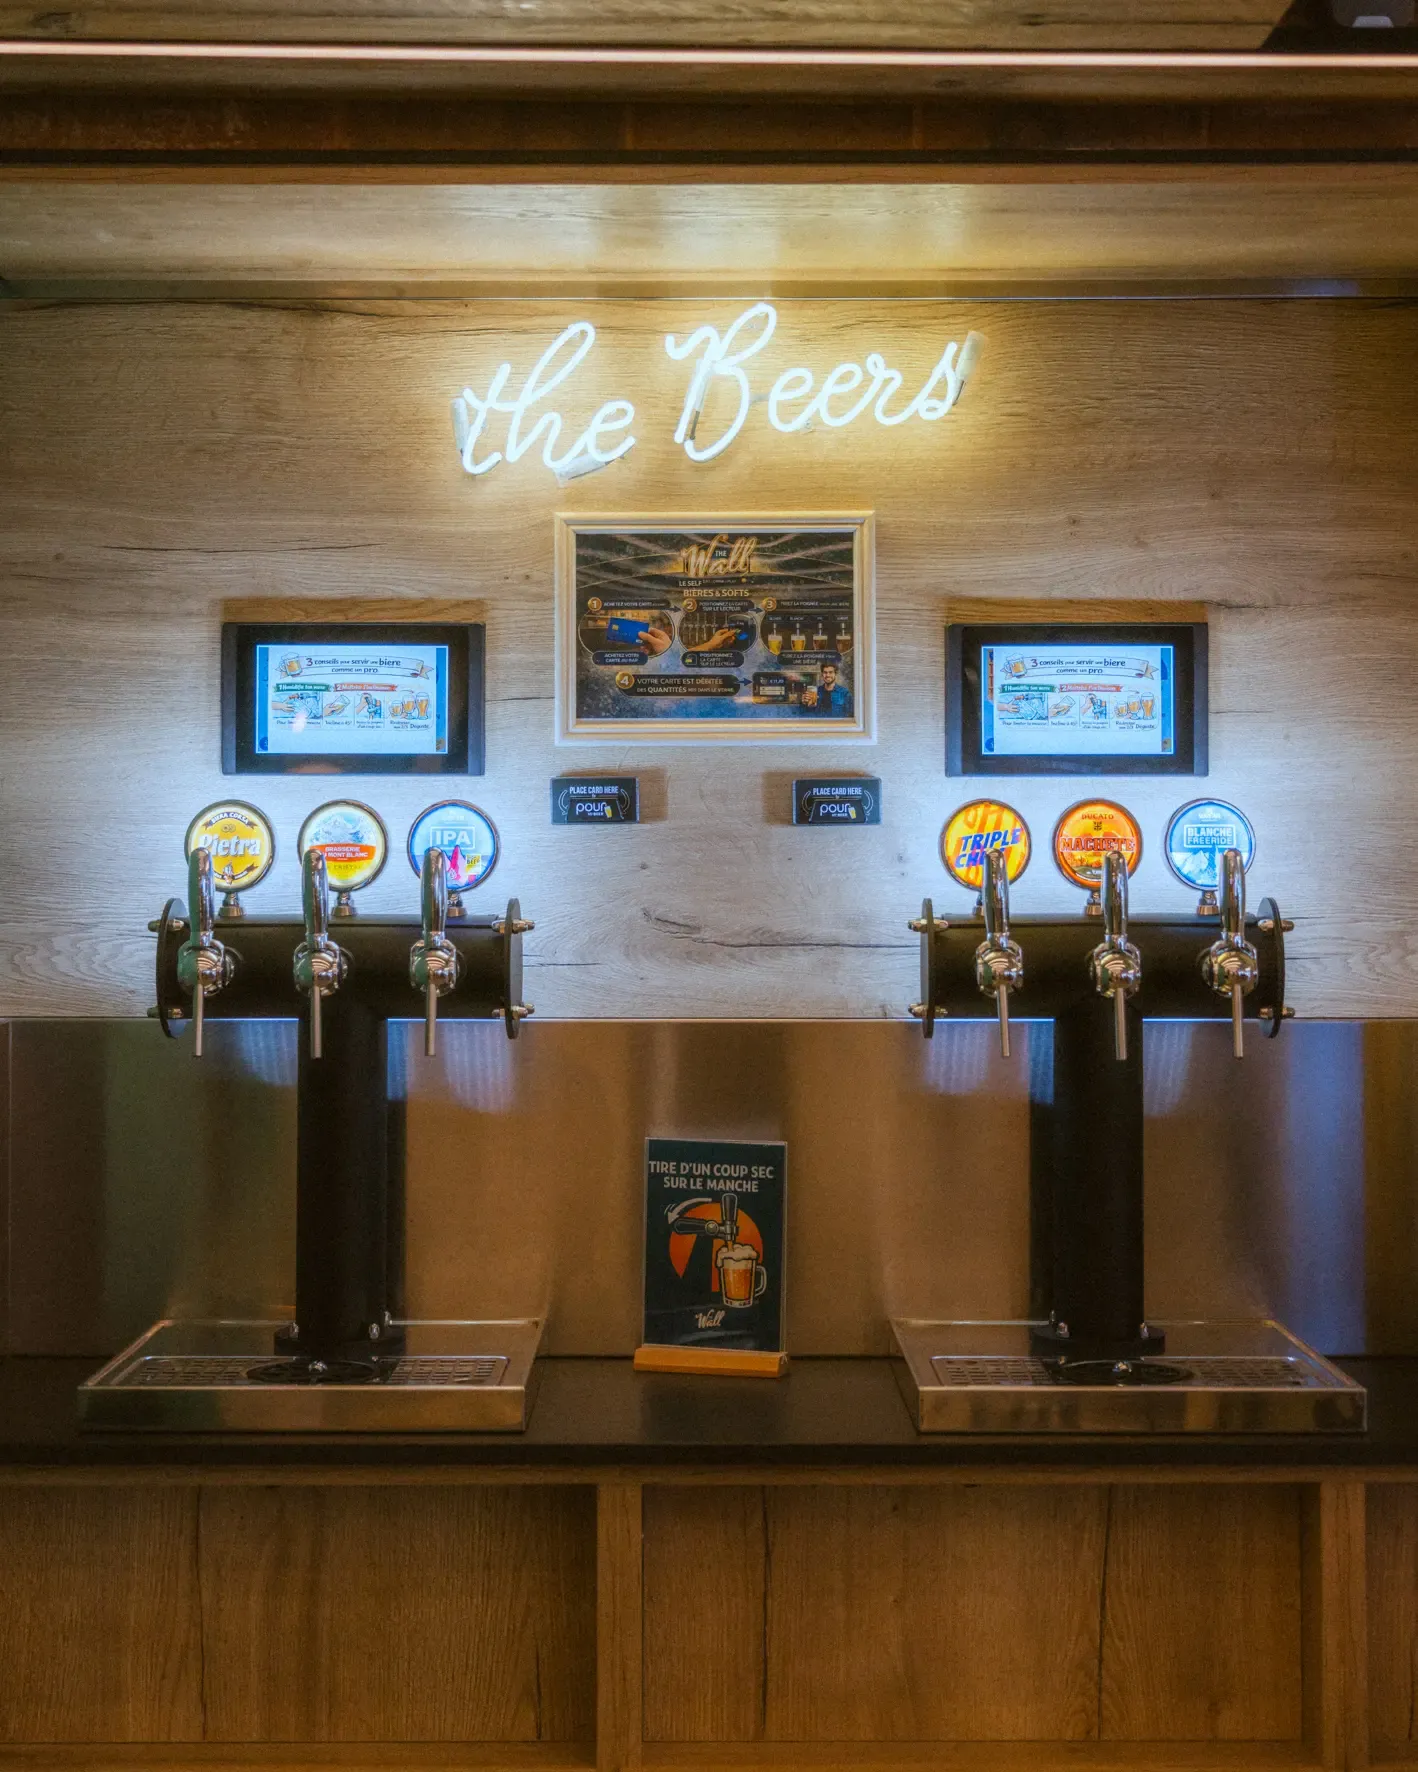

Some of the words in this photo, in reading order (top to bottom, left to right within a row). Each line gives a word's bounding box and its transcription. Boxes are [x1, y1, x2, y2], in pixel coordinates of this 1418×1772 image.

[462, 322, 636, 476] the
[665, 302, 960, 463] Beers
[680, 533, 758, 578] Wall
[683, 588, 714, 597] BIÈRES
[715, 589, 721, 597] &
[722, 589, 750, 597] SOFTS
[592, 601, 597, 609] 1
[686, 602, 694, 610] 2
[766, 600, 773, 609] 3
[305, 657, 313, 666] 3
[1031, 658, 1038, 667] 3
[1039, 658, 1064, 666] conseils
[620, 676, 629, 686] 4
[569, 786, 587, 794] PLACE
[587, 786, 603, 794] CARD
[603, 785, 619, 794] HERE
[812, 787, 831, 795] PLACE
[831, 787, 847, 795] CARD
[847, 787, 862, 795] HERE
[575, 801, 607, 815] pour
[819, 803, 851, 816] pour
[211, 812, 229, 824] BIERA
[229, 812, 249, 824] CORSA
[435, 830, 471, 845] IPA
[1187, 827, 1232, 836] BLANCHE
[198, 833, 261, 857] Pietra
[962, 828, 1023, 851] TRIPLE
[1061, 837, 1136, 851] MACHETE
[1187, 836, 1232, 845] FREERIDE
[648, 1160, 677, 1174] TIRE
[680, 1162, 711, 1176] D'UN
[713, 1164, 748, 1177] COUP
[751, 1166, 775, 1178] SEC
[663, 1176, 687, 1189] SUR
[690, 1178, 703, 1189] LE
[706, 1179, 759, 1192] MANCHE
[695, 1309, 726, 1329] Wall
